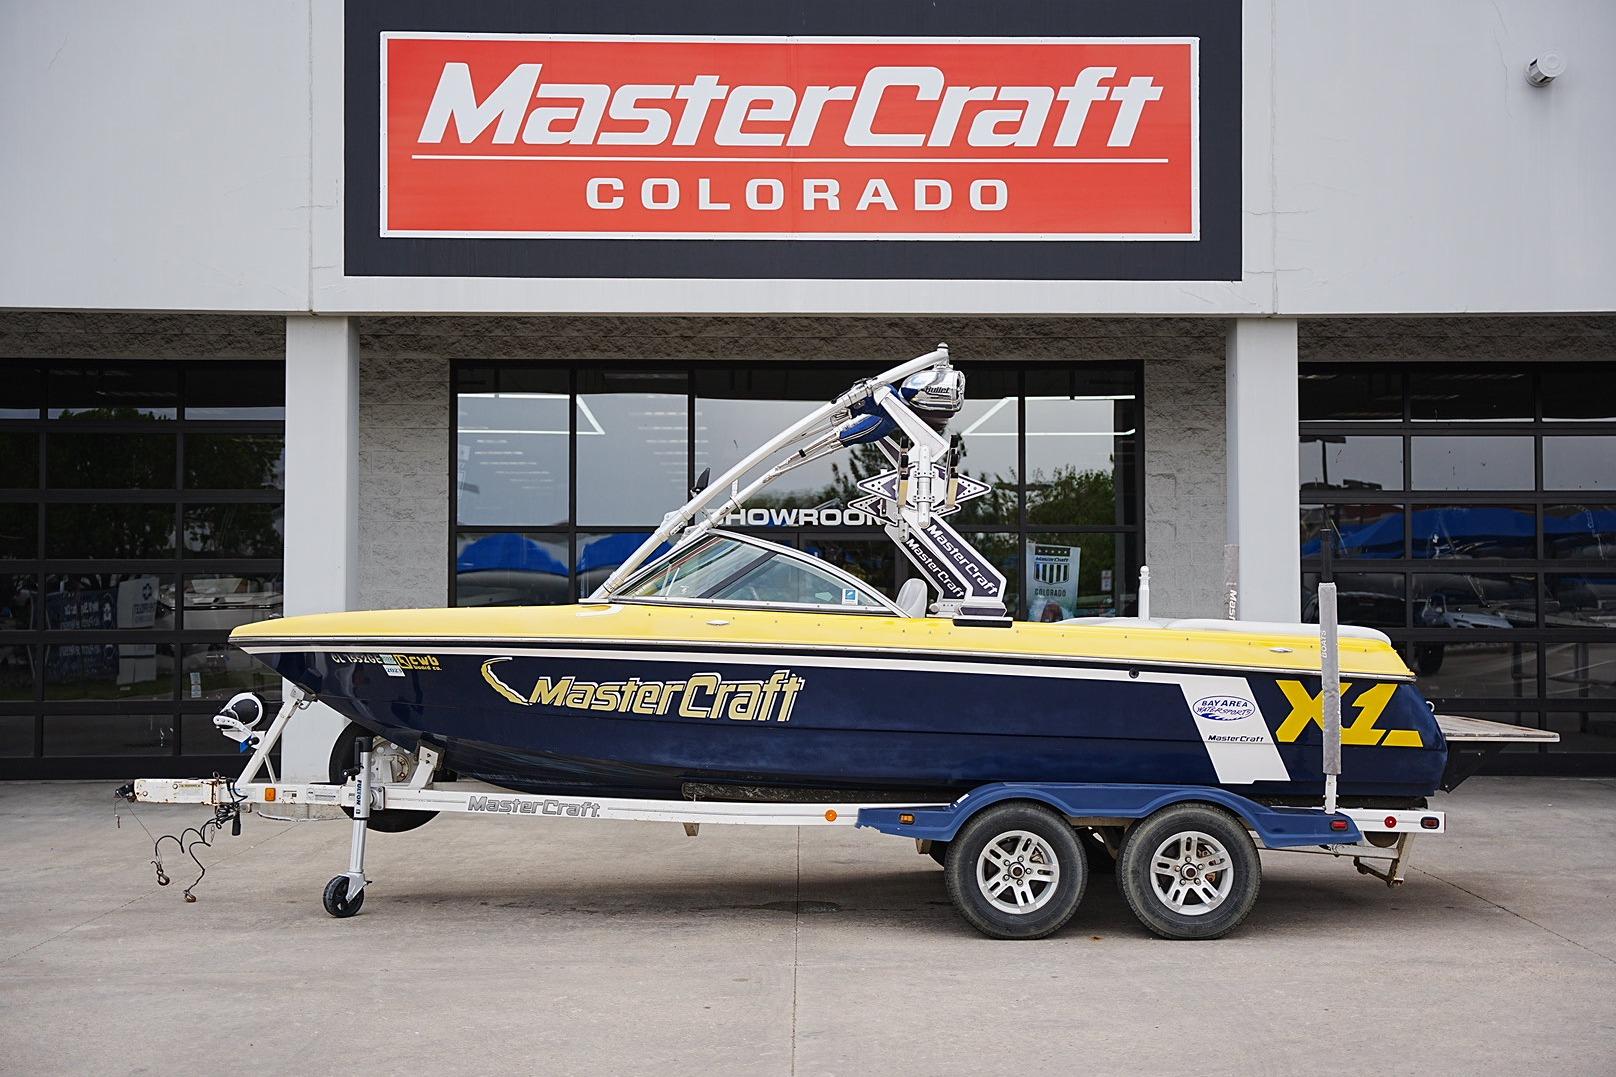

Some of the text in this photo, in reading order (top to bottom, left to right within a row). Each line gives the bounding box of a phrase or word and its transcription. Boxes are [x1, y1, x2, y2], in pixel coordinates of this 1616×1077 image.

[418, 62, 1163, 148] MasterCraft
[585, 177, 1010, 212] COLORADO
[905, 538, 965, 598] MasterCraft
[926, 524, 999, 596] MasterCraft
[1034, 588, 1067, 598] COLORADO
[408, 655, 440, 666] cwb
[529, 668, 805, 723] MasterCraft
[1220, 700, 1248, 708] AREA
[1207, 734, 1264, 743] MasterCraft
[468, 795, 599, 818] MasterCraft
